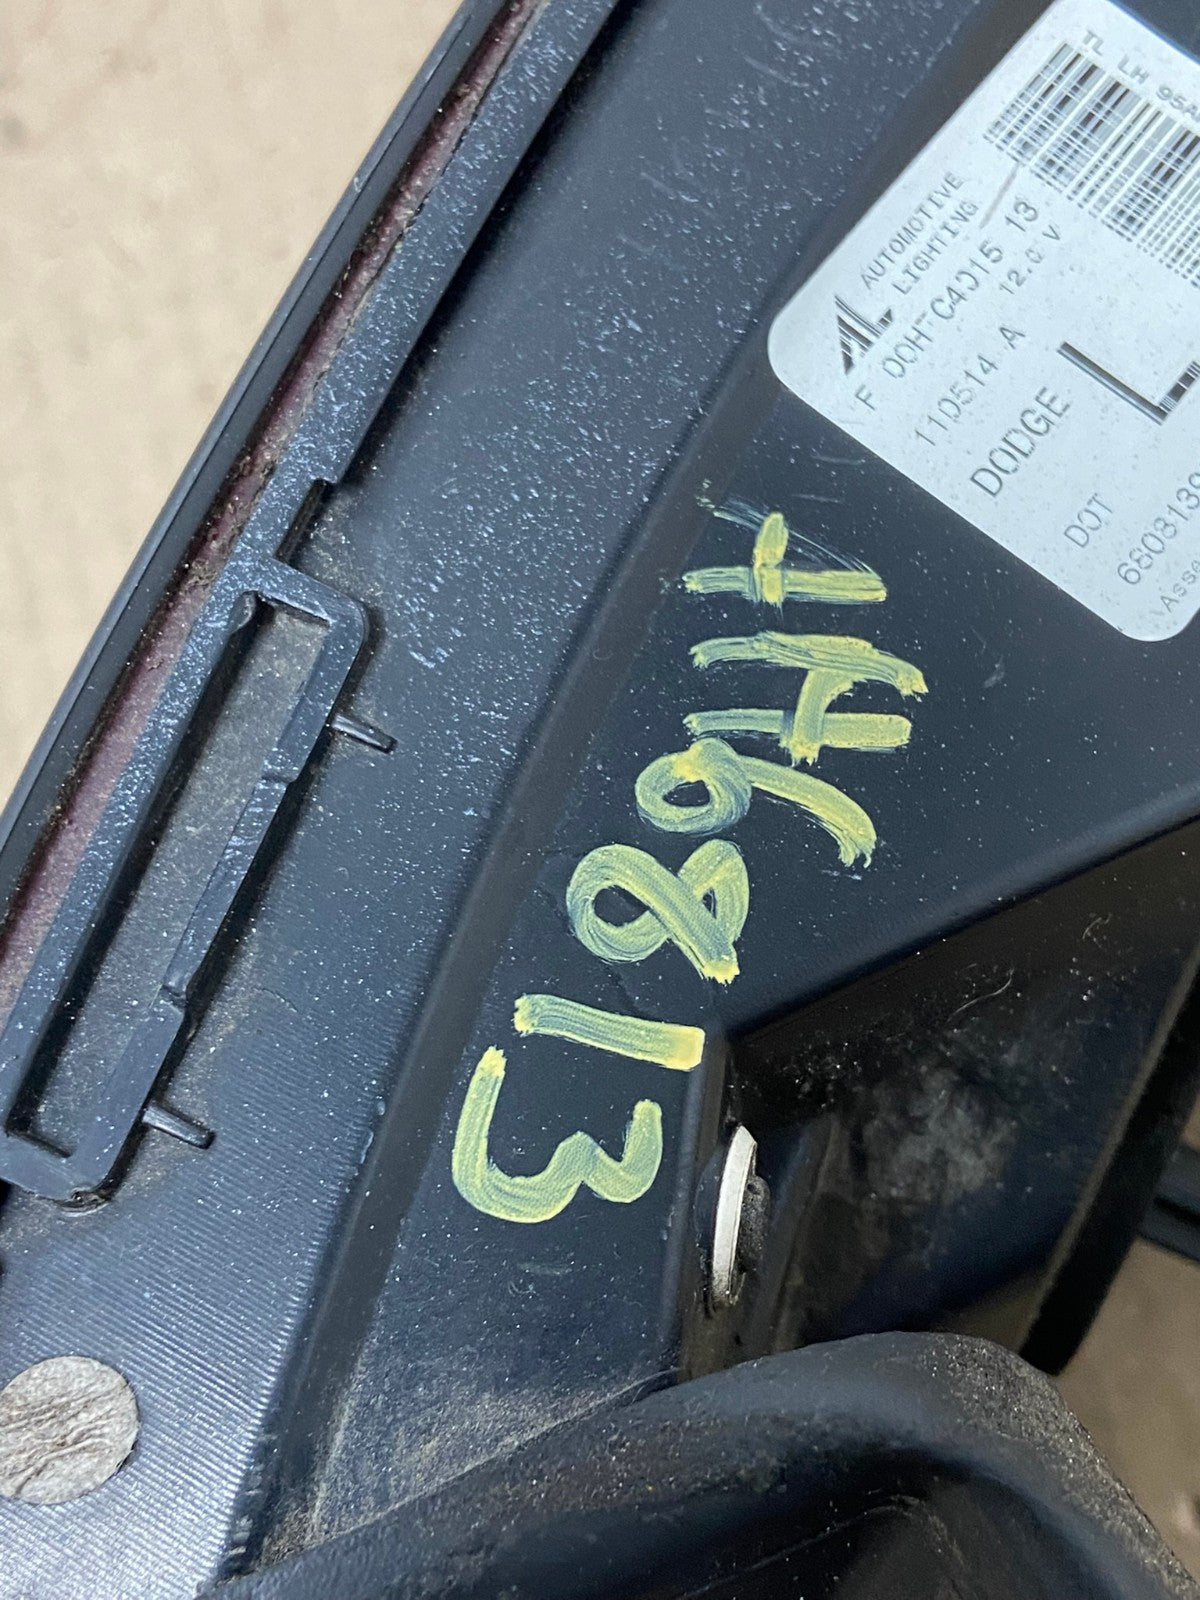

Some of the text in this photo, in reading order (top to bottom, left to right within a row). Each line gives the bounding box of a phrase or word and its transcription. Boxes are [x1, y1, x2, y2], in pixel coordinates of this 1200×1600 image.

[1082, 30, 1104, 56] TL
[1117, 54, 1150, 85] LH
[860, 172, 965, 290] AUTOMOTIVE
[891, 201, 979, 295] LIGHTING
[1041, 224, 1061, 242] V
[855, 384, 876, 411] F
[1004, 195, 1039, 233] 13
[914, 325, 1026, 446] 110514 A
[969, 386, 1071, 498] DODGE
[1063, 492, 1114, 548] DOT
